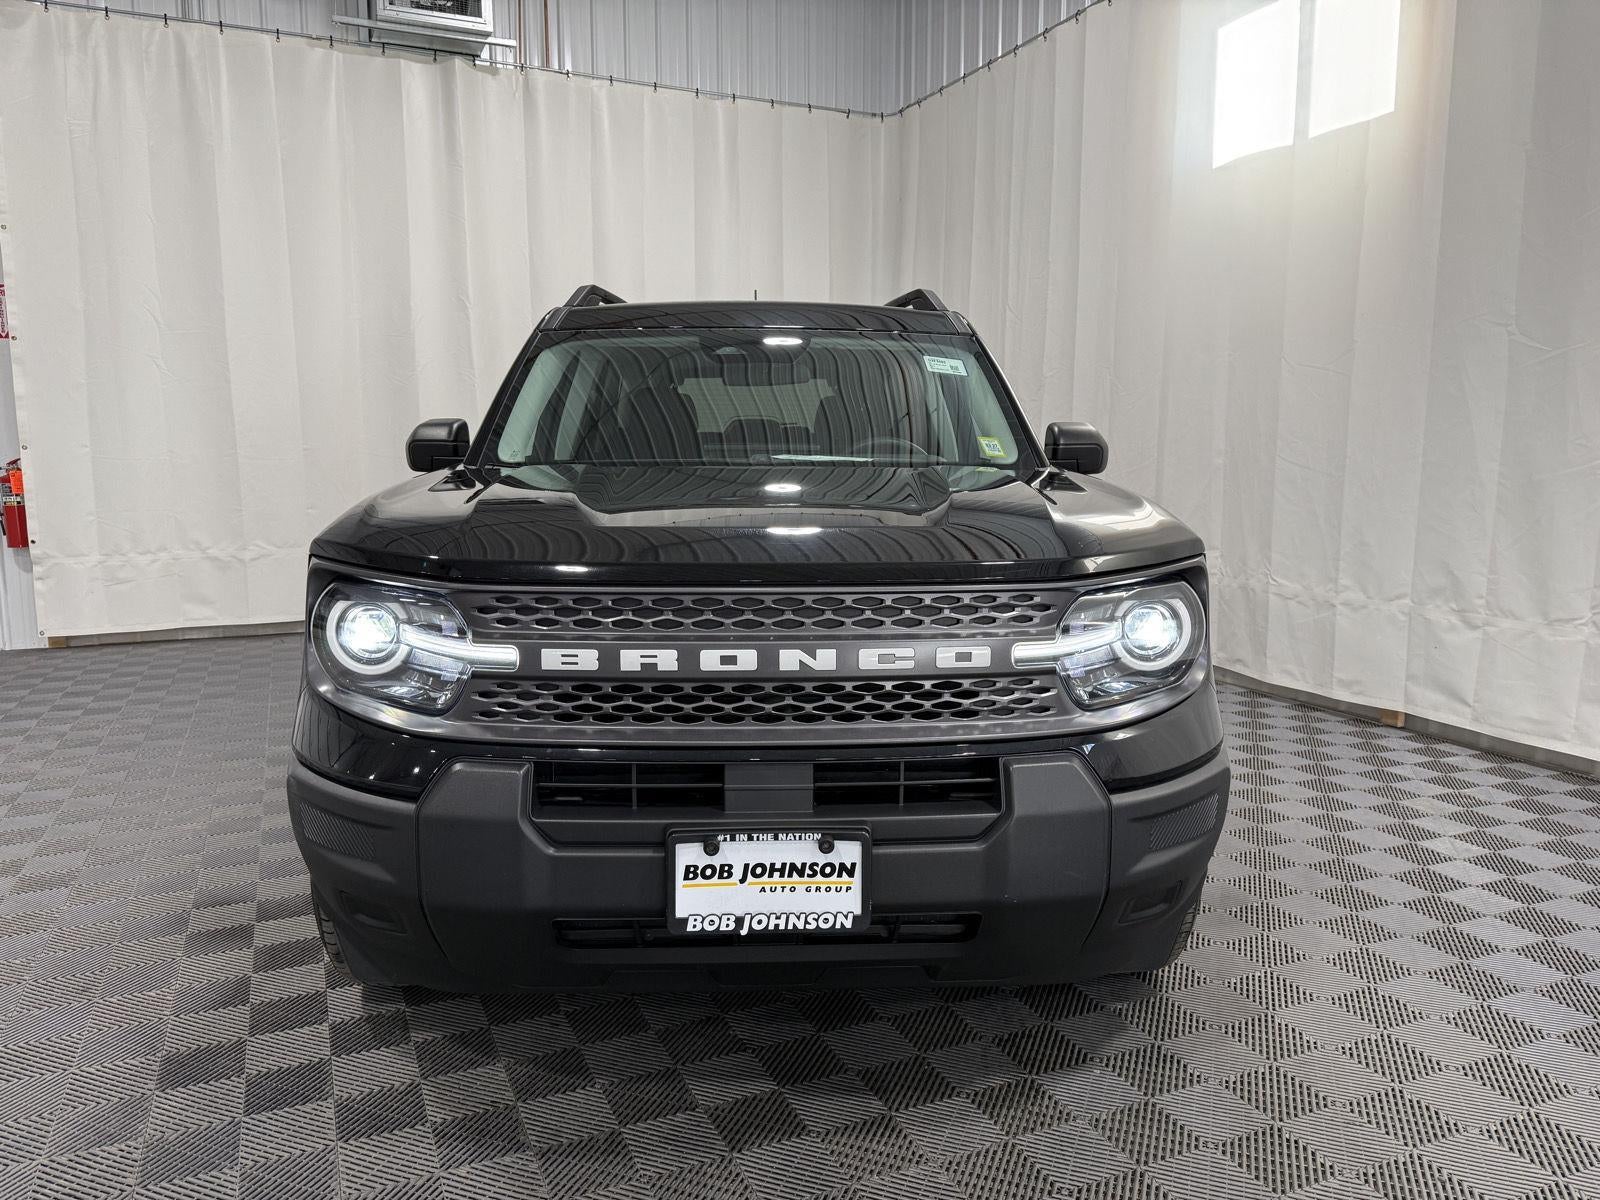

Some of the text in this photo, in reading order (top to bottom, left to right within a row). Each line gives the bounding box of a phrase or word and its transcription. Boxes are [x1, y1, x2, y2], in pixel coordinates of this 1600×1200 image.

[540, 646, 992, 671] BRONCO
[717, 833, 822, 842] #1 IN THE NATION
[683, 862, 857, 884] BOB JOHNSON
[805, 885, 852, 893] GROUP
[686, 912, 854, 936] BOB JOHNSON
